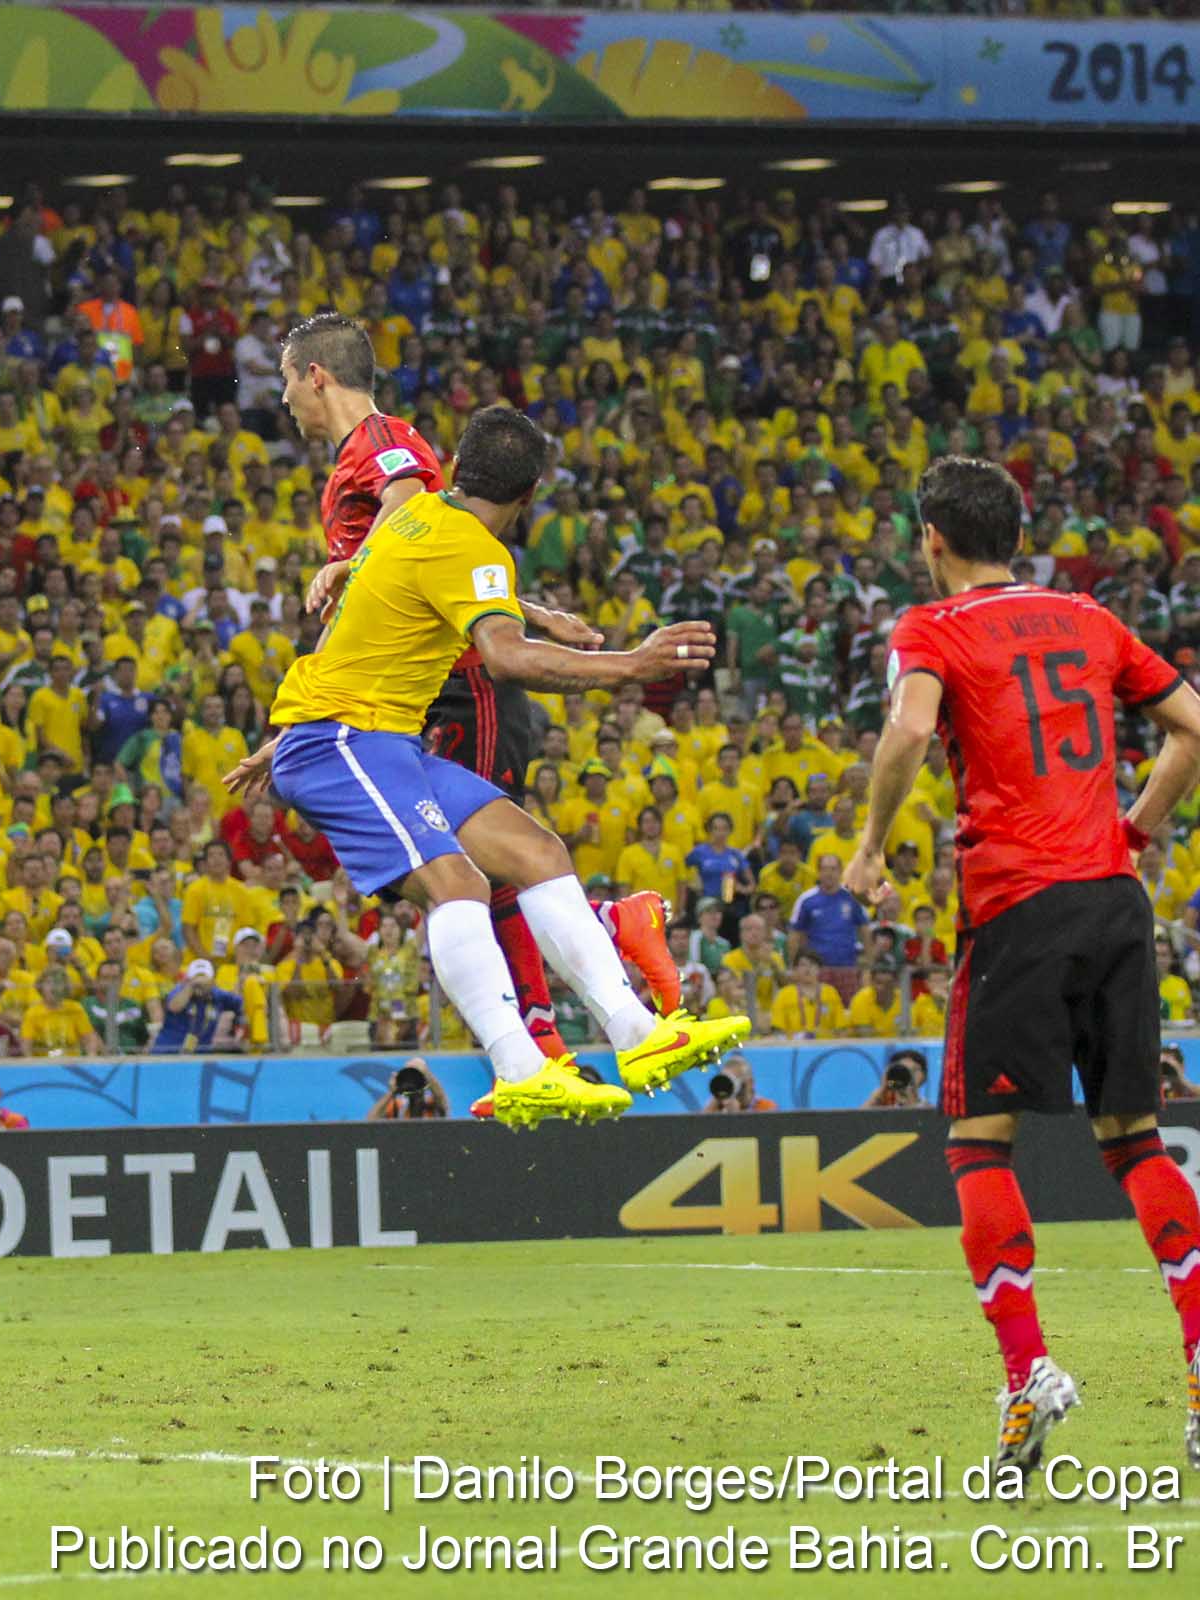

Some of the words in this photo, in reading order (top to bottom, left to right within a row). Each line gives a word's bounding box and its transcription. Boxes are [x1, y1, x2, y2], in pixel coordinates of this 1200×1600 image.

[1044, 41, 1196, 104] 2014
[1010, 649, 1103, 777] 15
[618, 1131, 926, 1235] 4K
